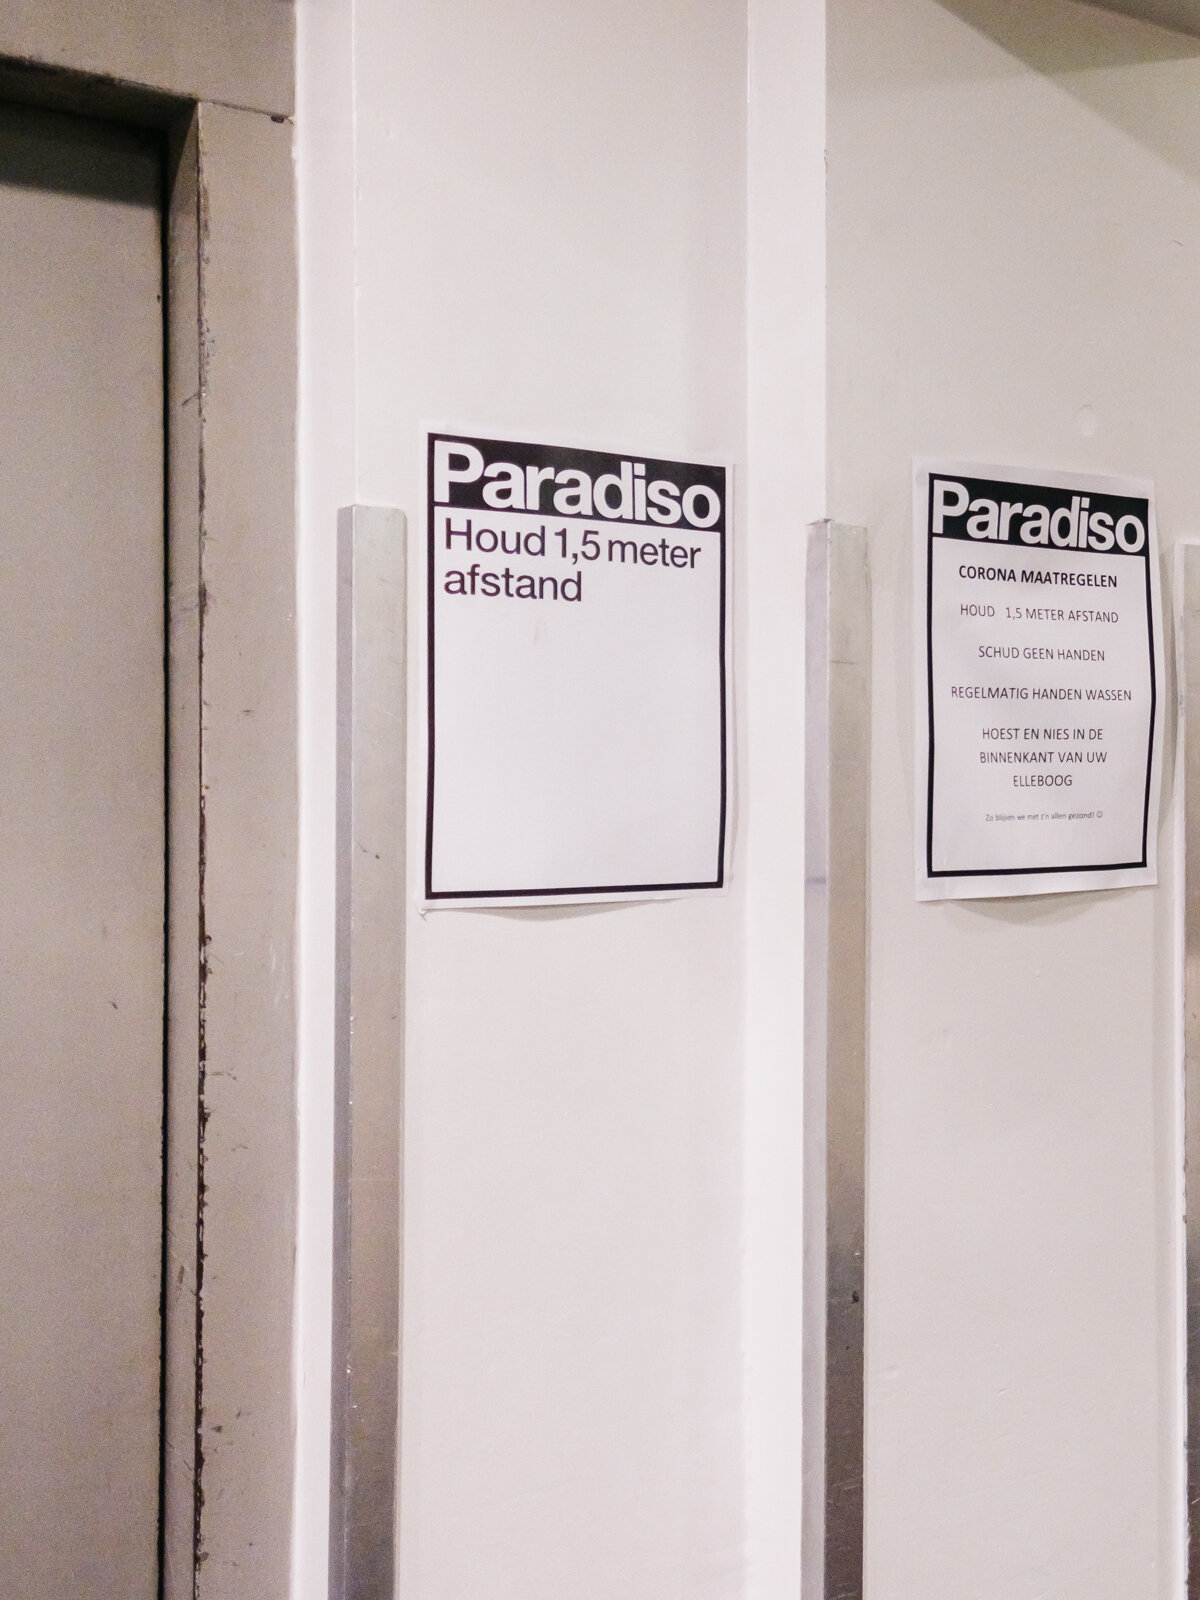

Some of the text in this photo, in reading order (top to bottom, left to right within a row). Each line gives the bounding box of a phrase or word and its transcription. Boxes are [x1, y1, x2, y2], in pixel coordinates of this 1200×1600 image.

[433, 439, 721, 529] Paradiso
[932, 478, 1146, 553] Paradiso
[445, 517, 702, 569] Houd 1,5 meter
[443, 563, 582, 602] afstand
[959, 565, 1118, 588] CORONA MAATREGELEN
[960, 603, 1119, 623] HOUD 1,5 METER AFSTAND
[978, 645, 1105, 662] SCHUD GEEN HANDEN
[951, 686, 1132, 701] REGELMATIG HANDEN WASSEN
[982, 728, 1104, 740] HOEST EN NIES IN DE
[979, 751, 1108, 764] BINNENKANT VAN UW
[1013, 774, 1073, 787] ELLEBOOG
[1050, 812, 1067, 820] allen
